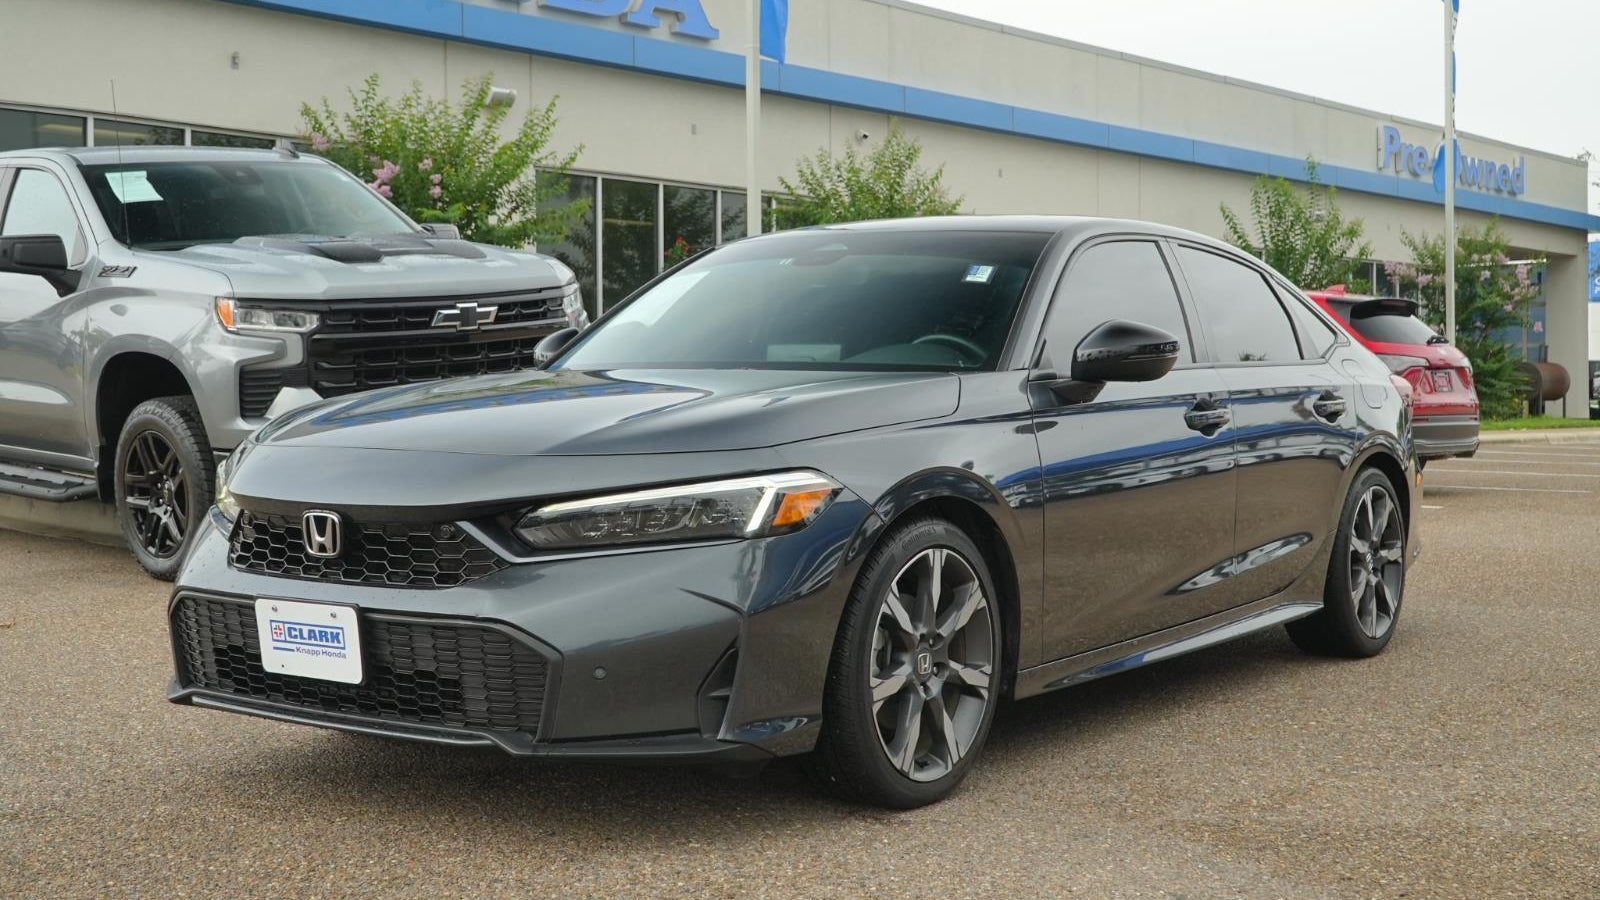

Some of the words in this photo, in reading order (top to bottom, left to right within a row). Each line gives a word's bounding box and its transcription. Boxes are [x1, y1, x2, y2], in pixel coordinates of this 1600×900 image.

[286, 626, 341, 645] CLARK
[295, 646, 321, 657] Knapp
[321, 648, 347, 659] Honda
